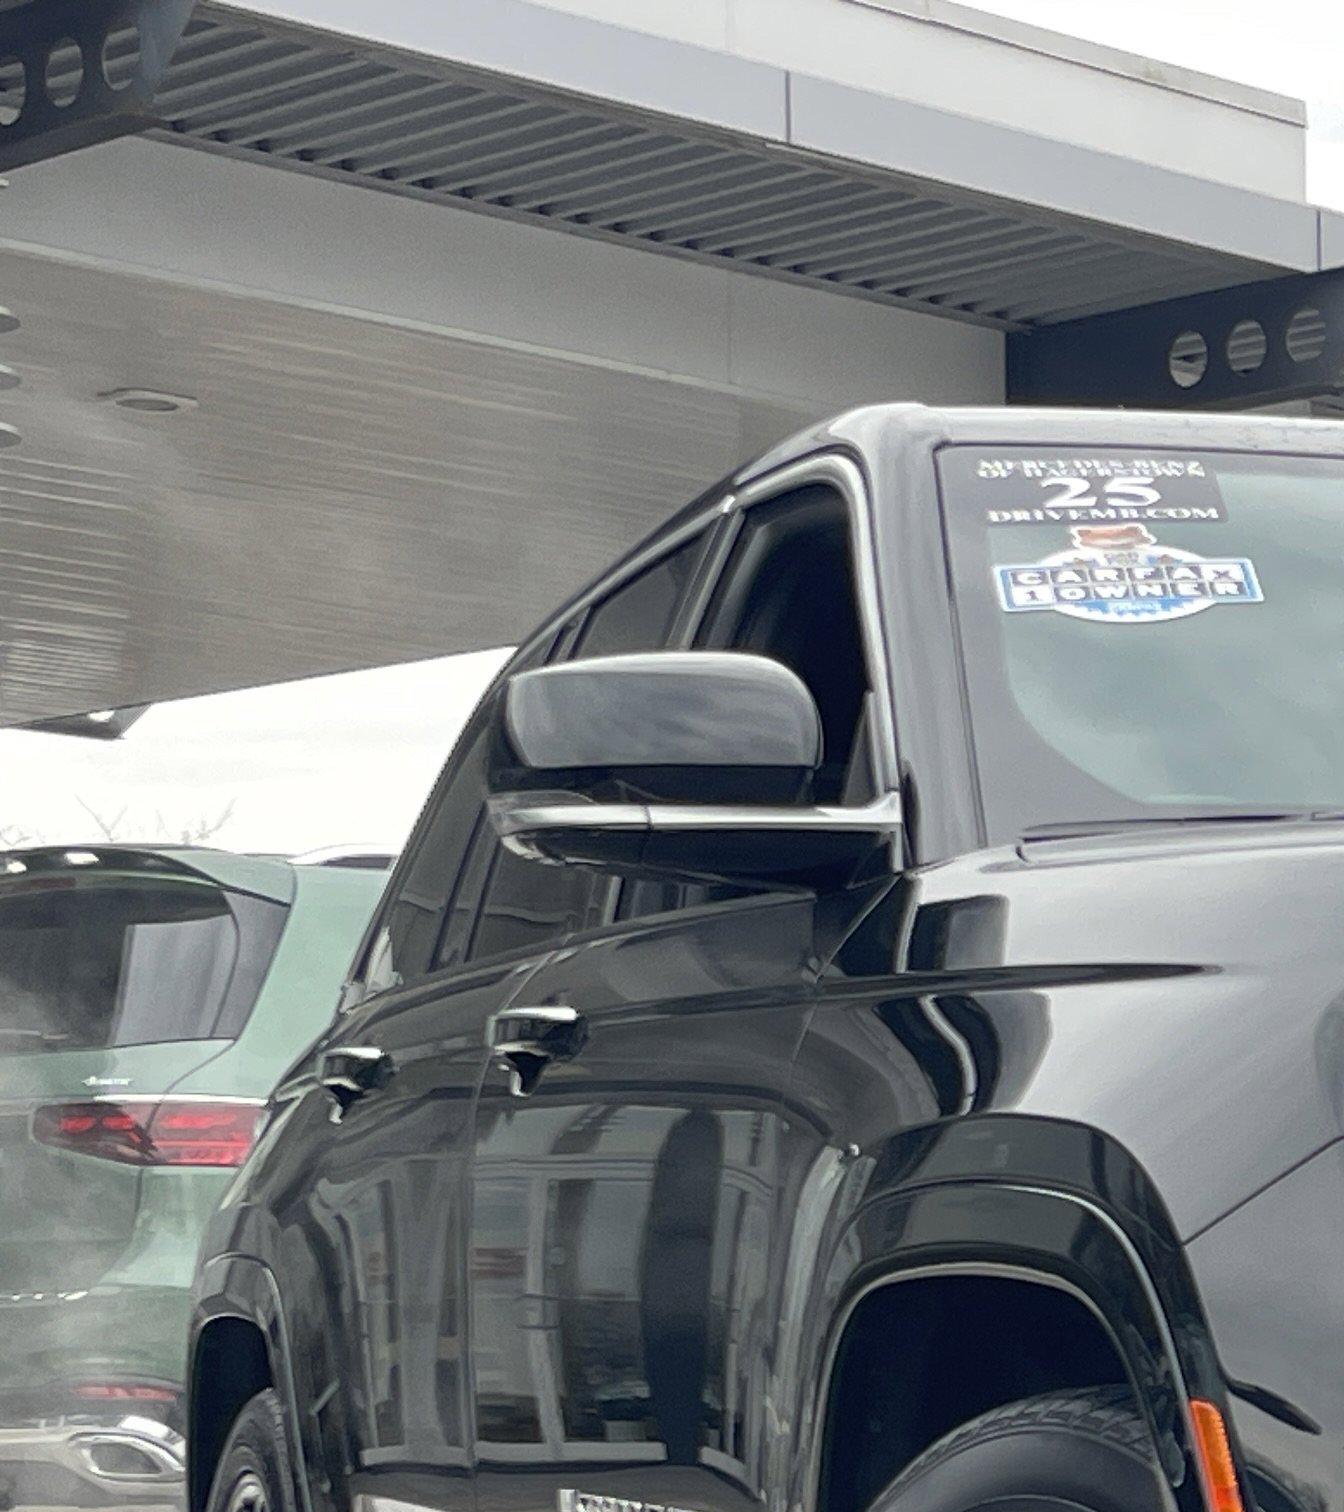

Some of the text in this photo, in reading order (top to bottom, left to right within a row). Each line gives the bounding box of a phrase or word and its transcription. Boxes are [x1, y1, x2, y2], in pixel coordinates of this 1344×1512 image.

[1040, 477, 1162, 508] 25
[987, 507, 1219, 523] DRIVEMB.COM
[1015, 566, 1240, 585] CARFAX
